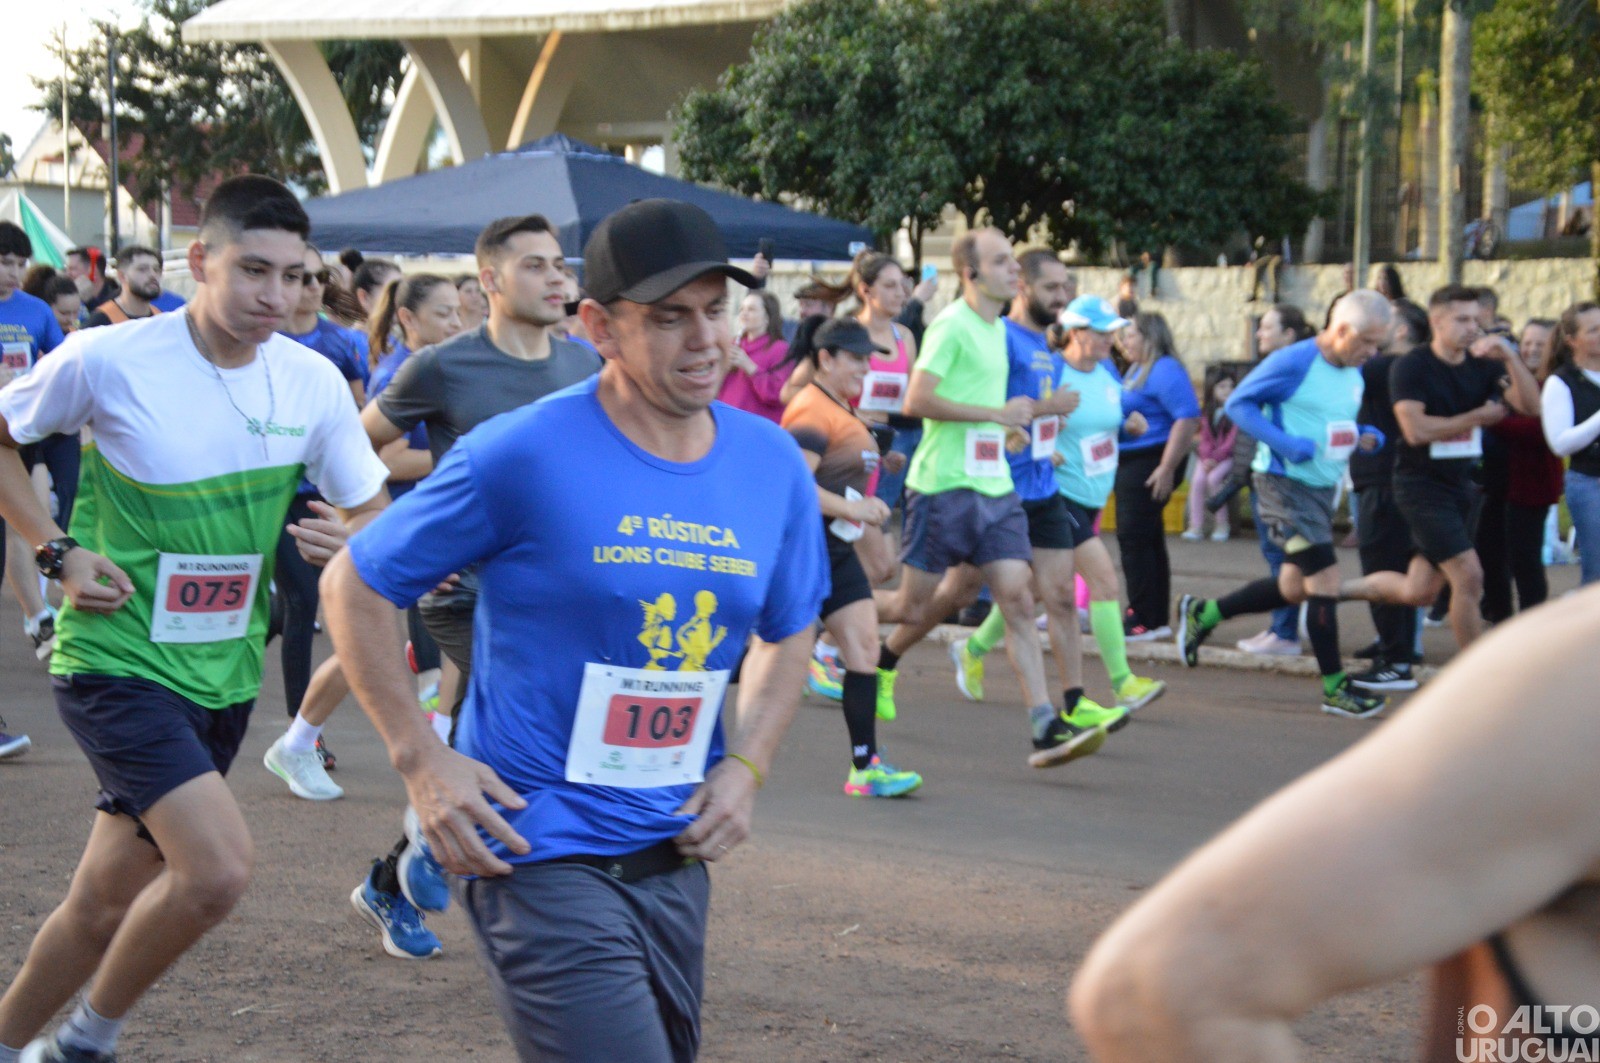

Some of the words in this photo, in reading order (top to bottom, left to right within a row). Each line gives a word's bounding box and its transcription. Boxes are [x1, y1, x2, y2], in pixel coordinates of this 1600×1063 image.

[647, 513, 741, 549] RÚSTICA
[593, 546, 653, 565] LIONS
[654, 548, 707, 570] CLUBE
[181, 581, 243, 607] 075
[626, 704, 693, 740] 103
